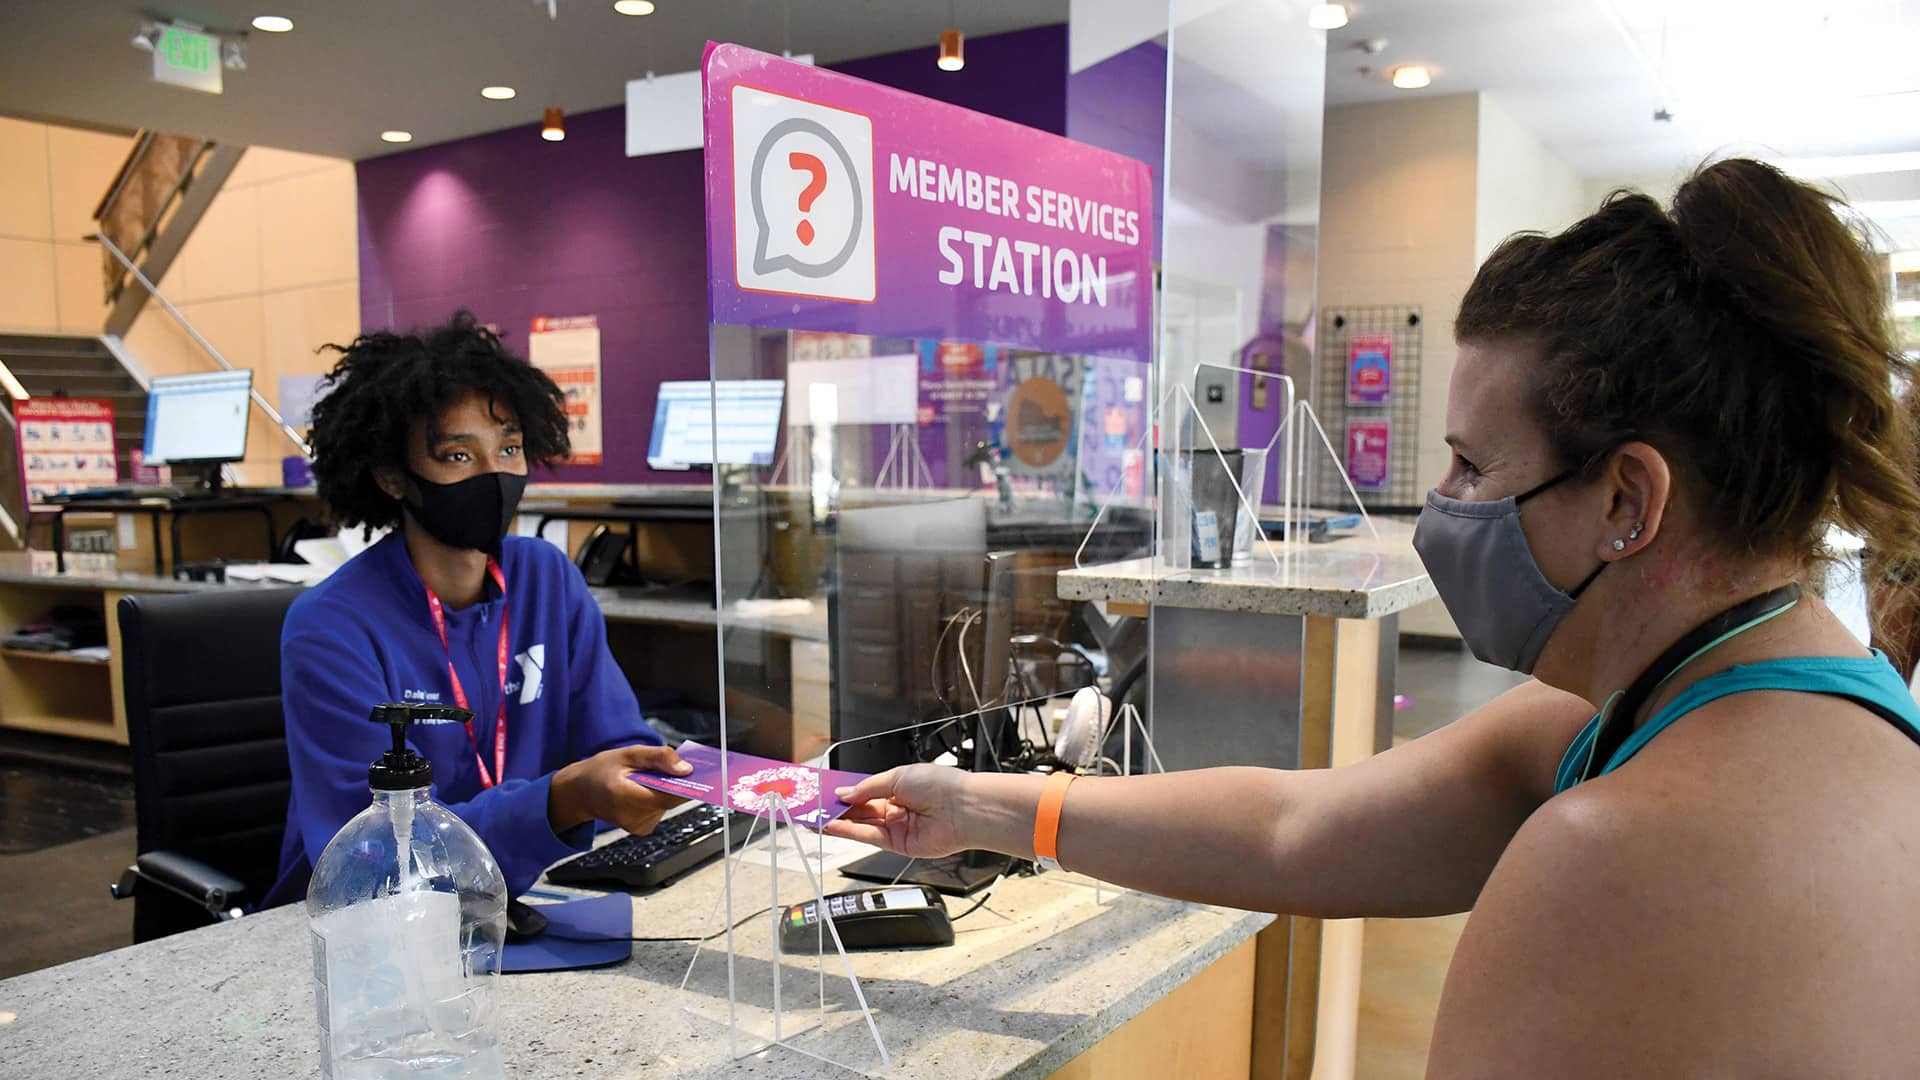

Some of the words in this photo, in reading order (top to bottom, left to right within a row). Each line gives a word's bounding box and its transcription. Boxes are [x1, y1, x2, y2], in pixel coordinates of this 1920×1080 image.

[166, 28, 209, 73] EXIT
[889, 153, 1020, 220] MEMBER
[1026, 185, 1140, 246] SERVICES
[938, 225, 1108, 307] STATION
